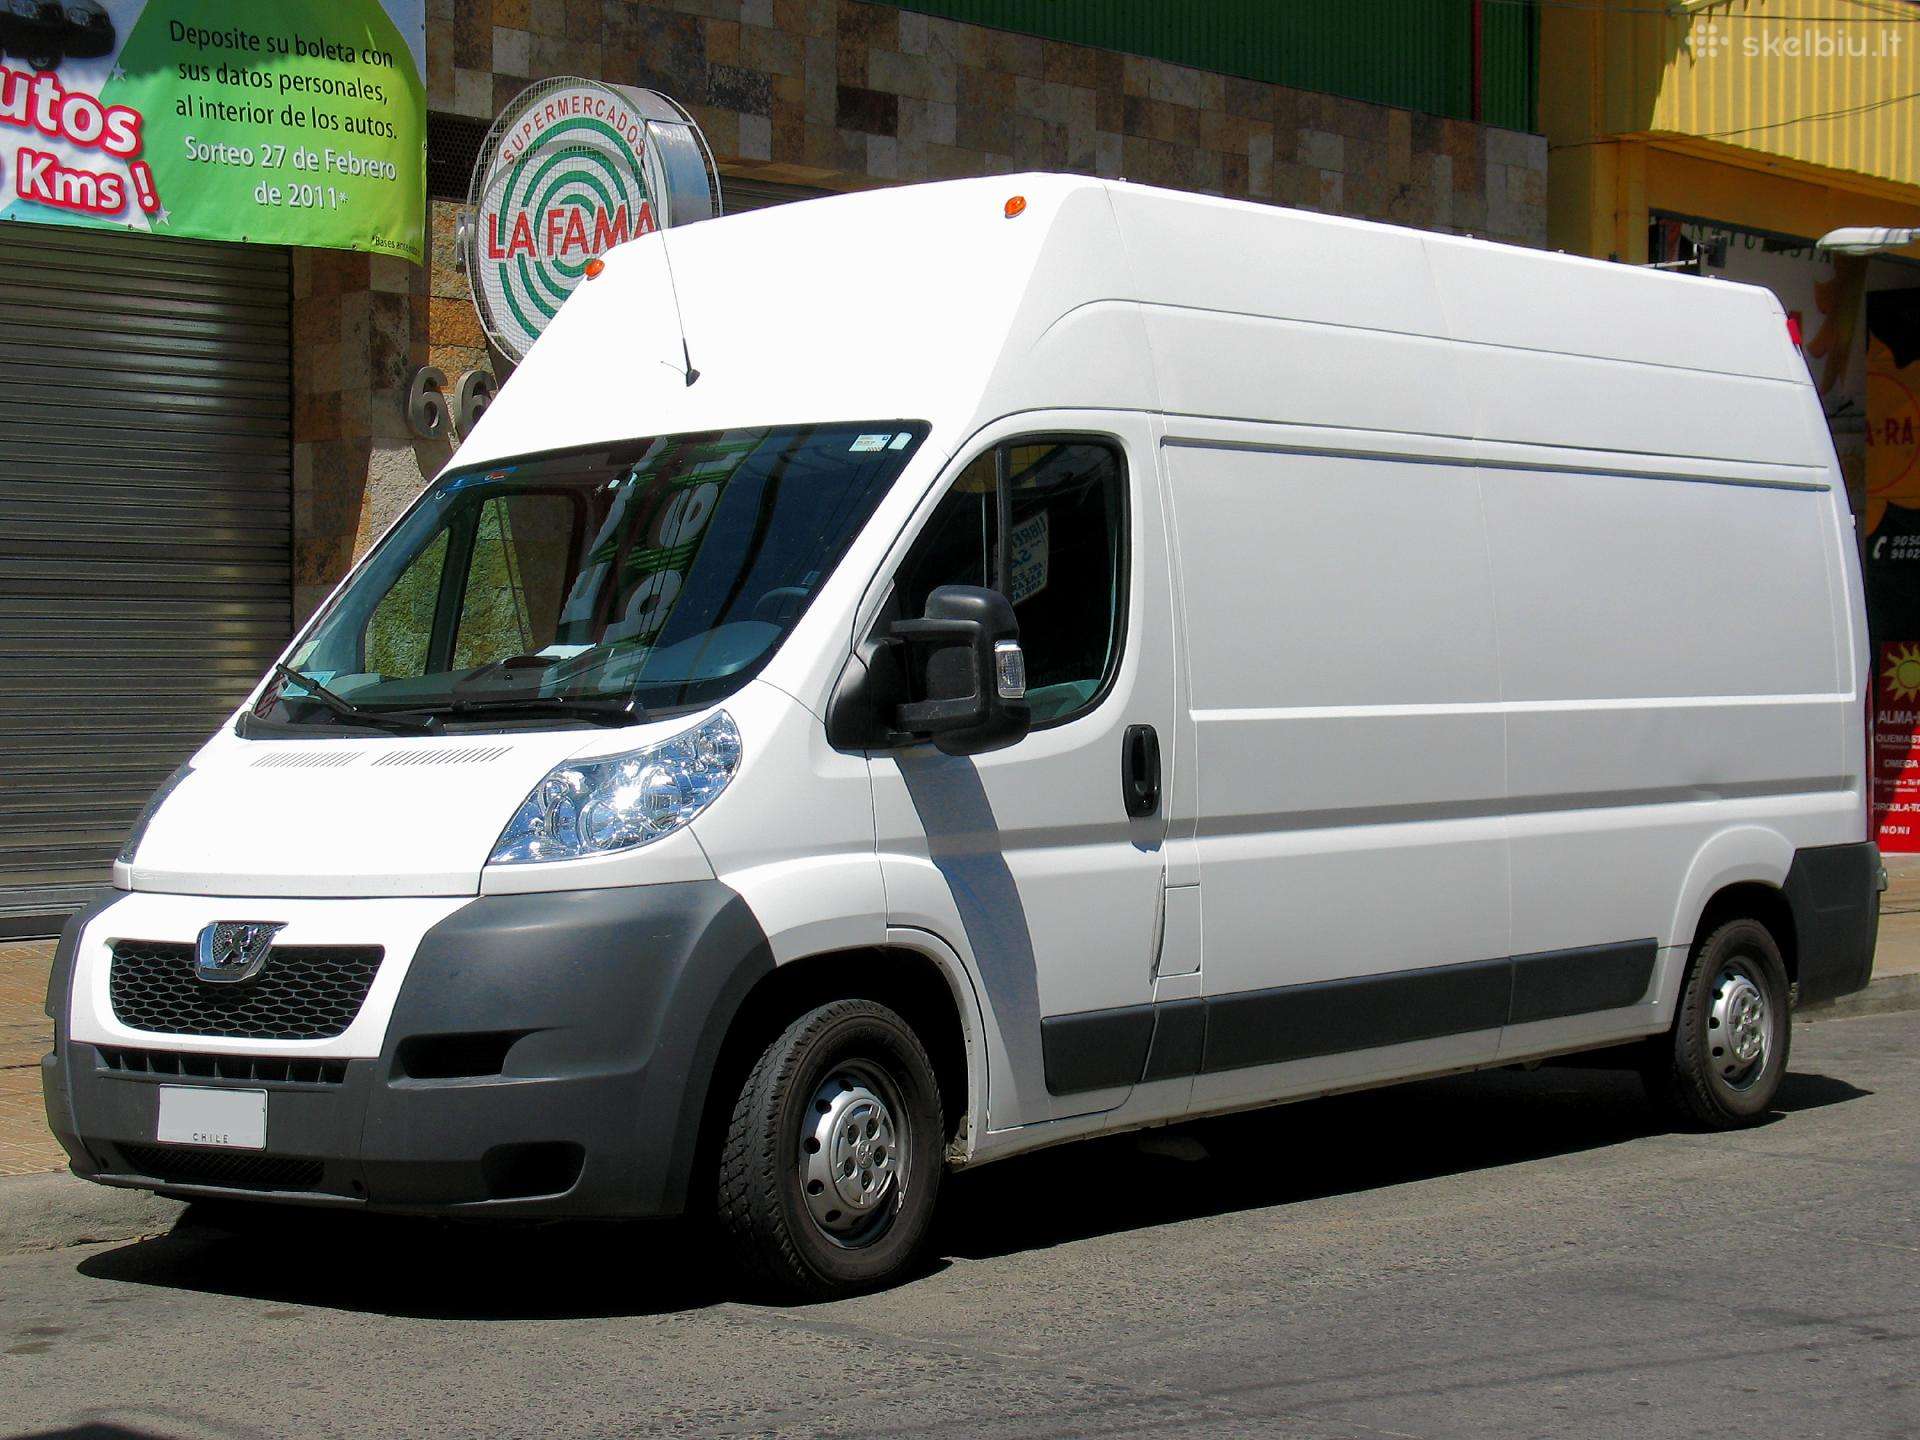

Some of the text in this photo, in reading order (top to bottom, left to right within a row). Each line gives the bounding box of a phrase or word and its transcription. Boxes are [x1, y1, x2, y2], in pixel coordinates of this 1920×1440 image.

[169, 20, 394, 69] Deposite su boleta con
[178, 61, 388, 105] sus datos personales,
[176, 94, 398, 140] al interior de los autos.
[503, 95, 645, 162] SUPERMERCADOS
[184, 135, 398, 182] Sorteo 27 de Febrero
[254, 180, 283, 206] de
[487, 201, 657, 260] LA FAMA
[1880, 825, 1911, 835] NONI
[192, 1132, 229, 1144] CHILE
